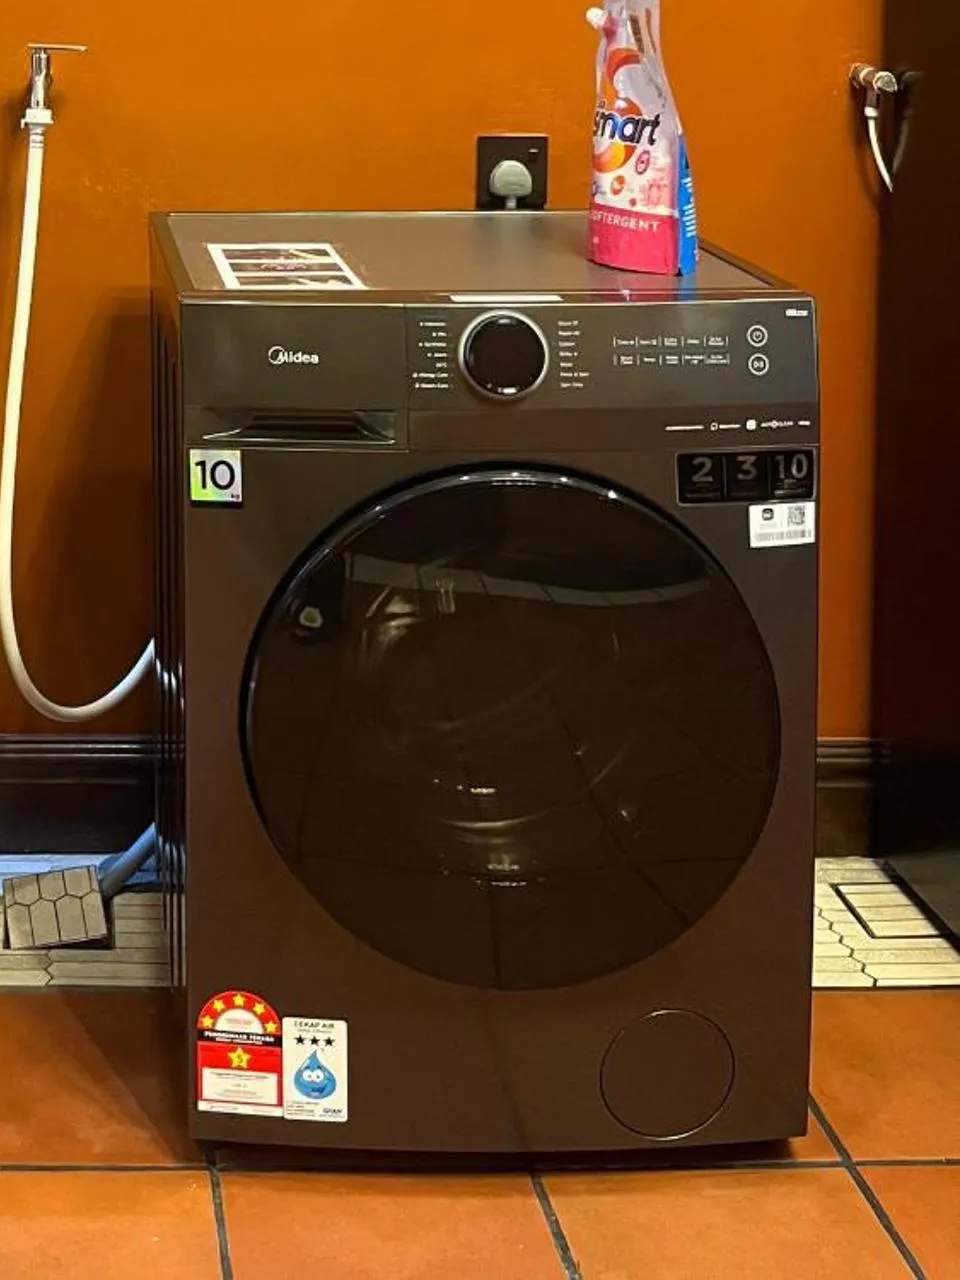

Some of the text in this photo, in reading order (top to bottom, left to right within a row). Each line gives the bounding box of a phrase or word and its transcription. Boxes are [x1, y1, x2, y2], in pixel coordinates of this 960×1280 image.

[268, 346, 320, 365] Midea
[194, 459, 236, 491] 10
[691, 456, 714, 482] 2
[736, 455, 758, 480] 3
[775, 453, 808, 479] 10
